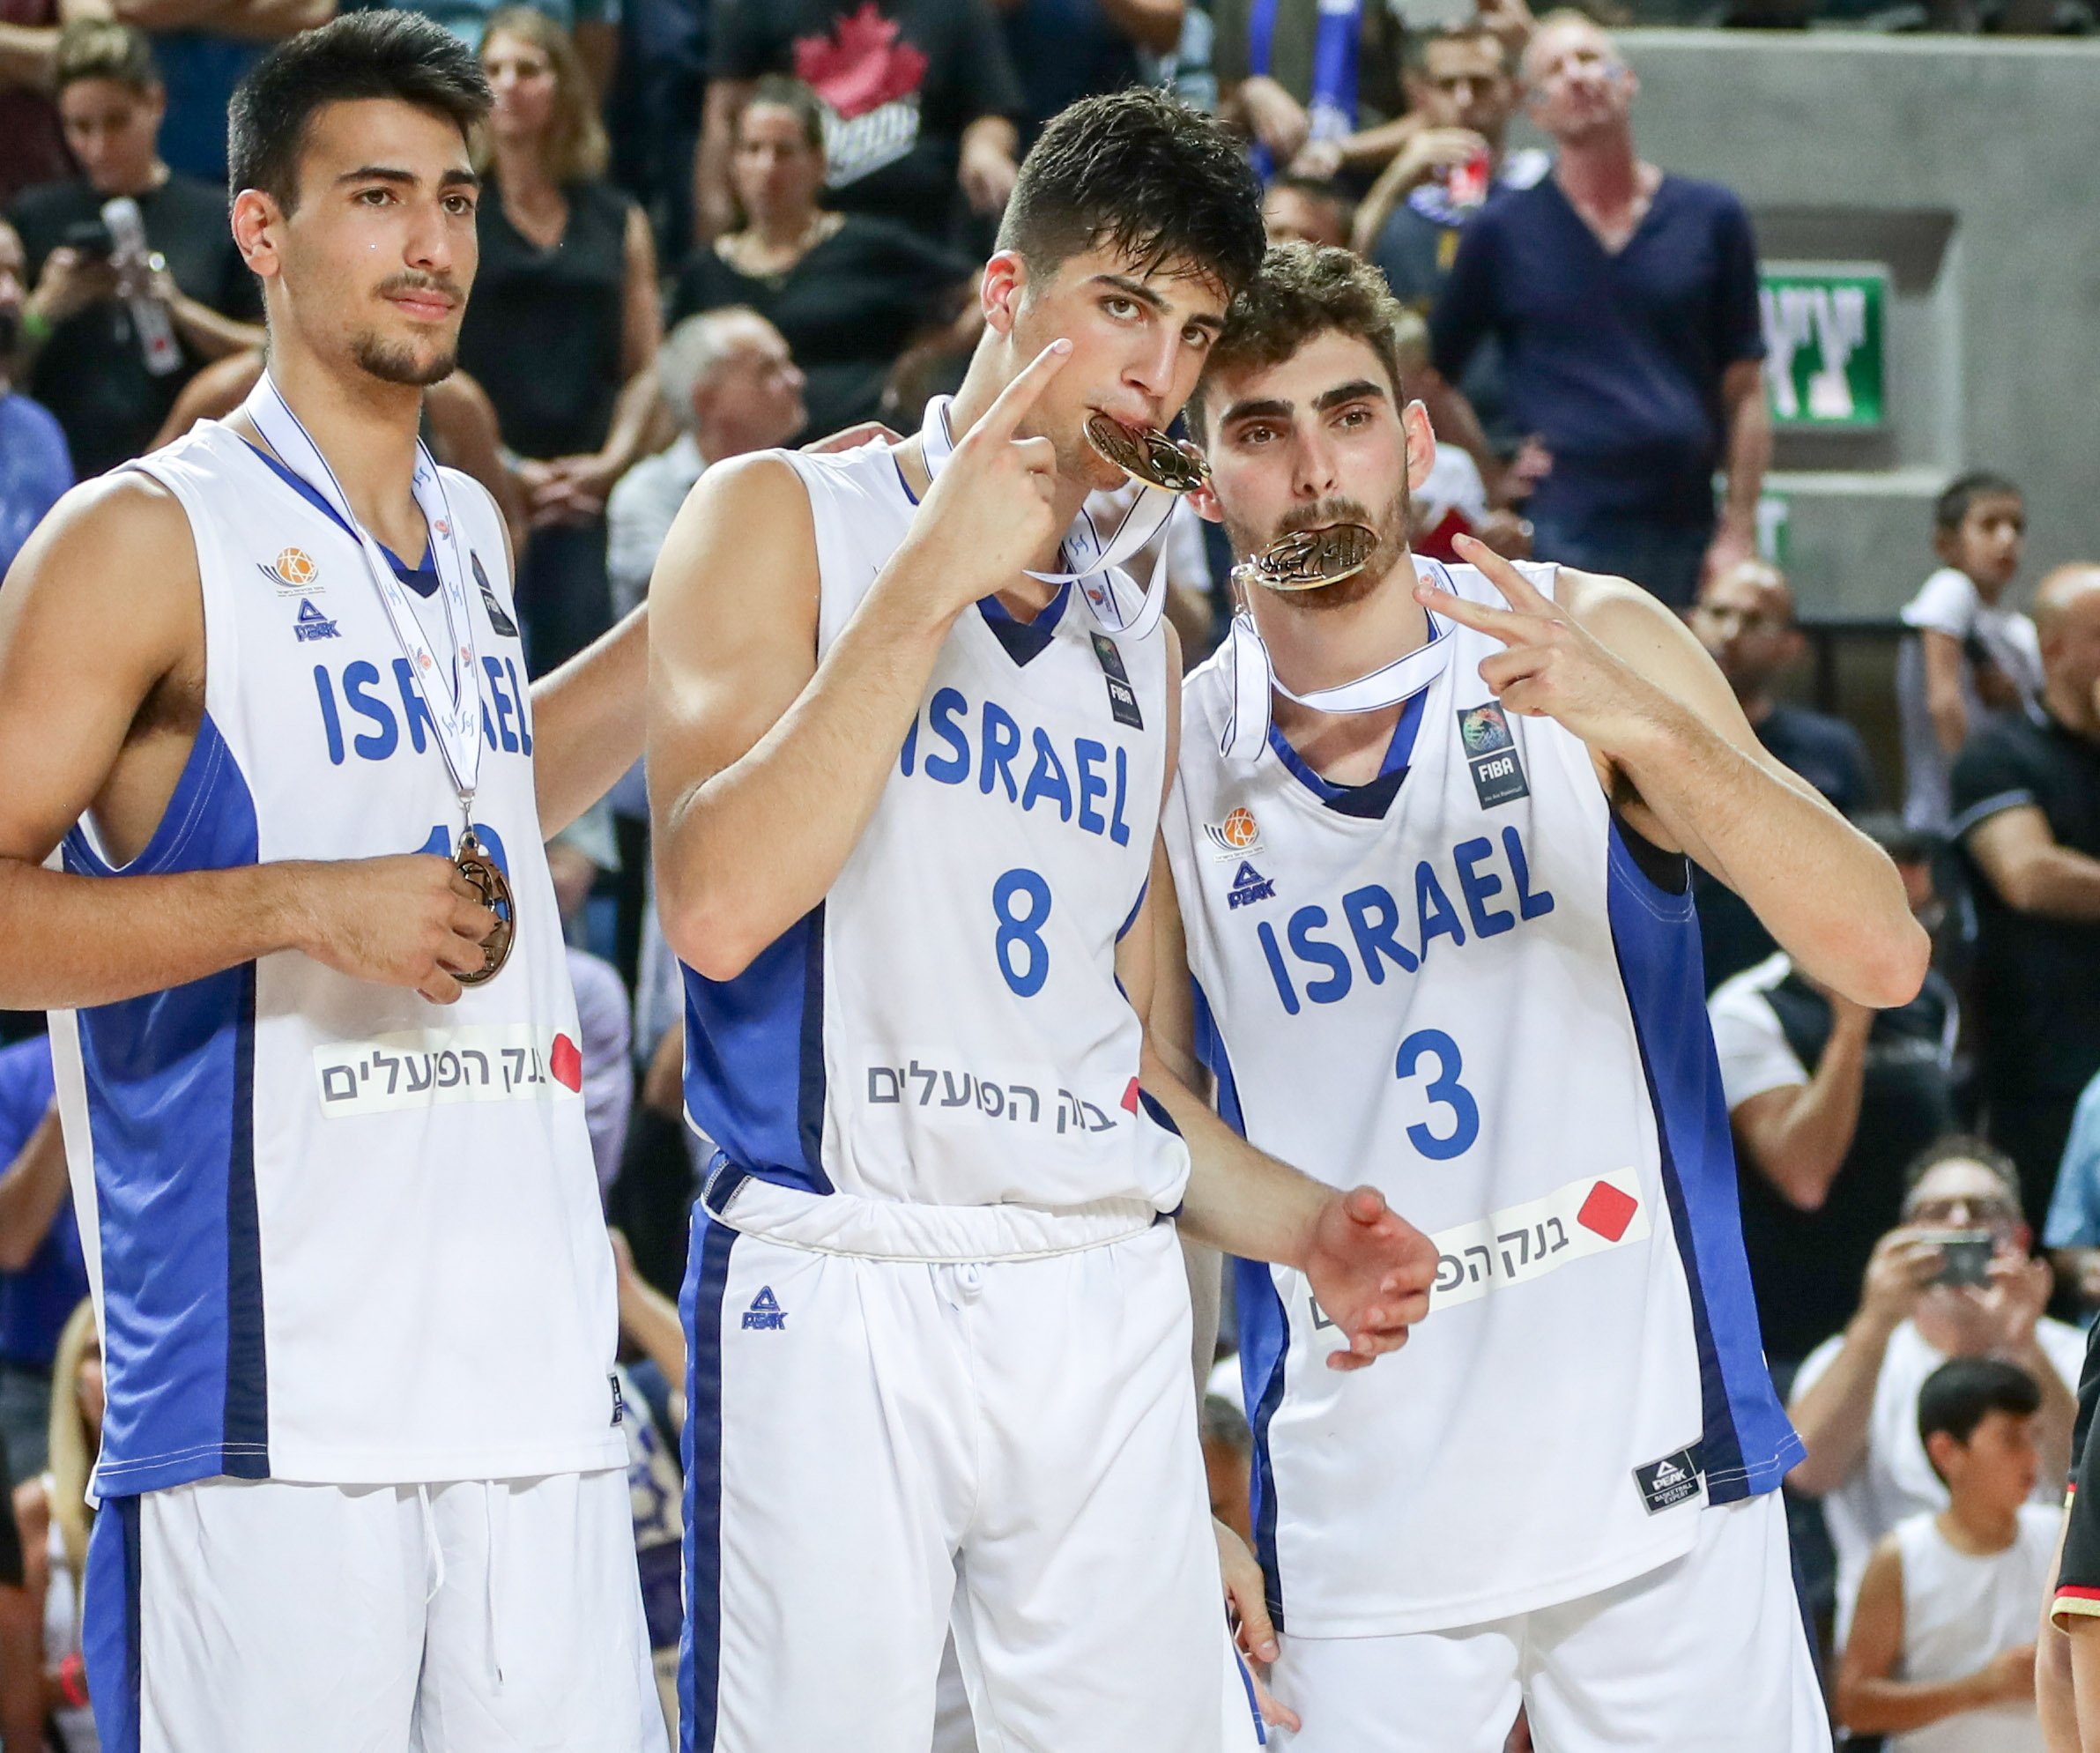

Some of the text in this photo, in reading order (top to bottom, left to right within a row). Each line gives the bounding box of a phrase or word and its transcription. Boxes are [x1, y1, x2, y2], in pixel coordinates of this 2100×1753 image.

[293, 619, 342, 643] PEAK
[1109, 683, 1133, 706] FIBA
[901, 687, 1130, 847] ISRAEL
[1478, 757, 1514, 783] FIBA
[1227, 878, 1276, 910] PEAK
[992, 868, 1052, 998] 8
[1258, 825, 1555, 1015] ISRAEL
[868, 1060, 1039, 1122] הפועלים
[1396, 1029, 1480, 1161] 3
[1497, 1216, 1569, 1278] בנק
[741, 1311, 788, 1330] PEAK
[1652, 1467, 1687, 1490] PEAK
